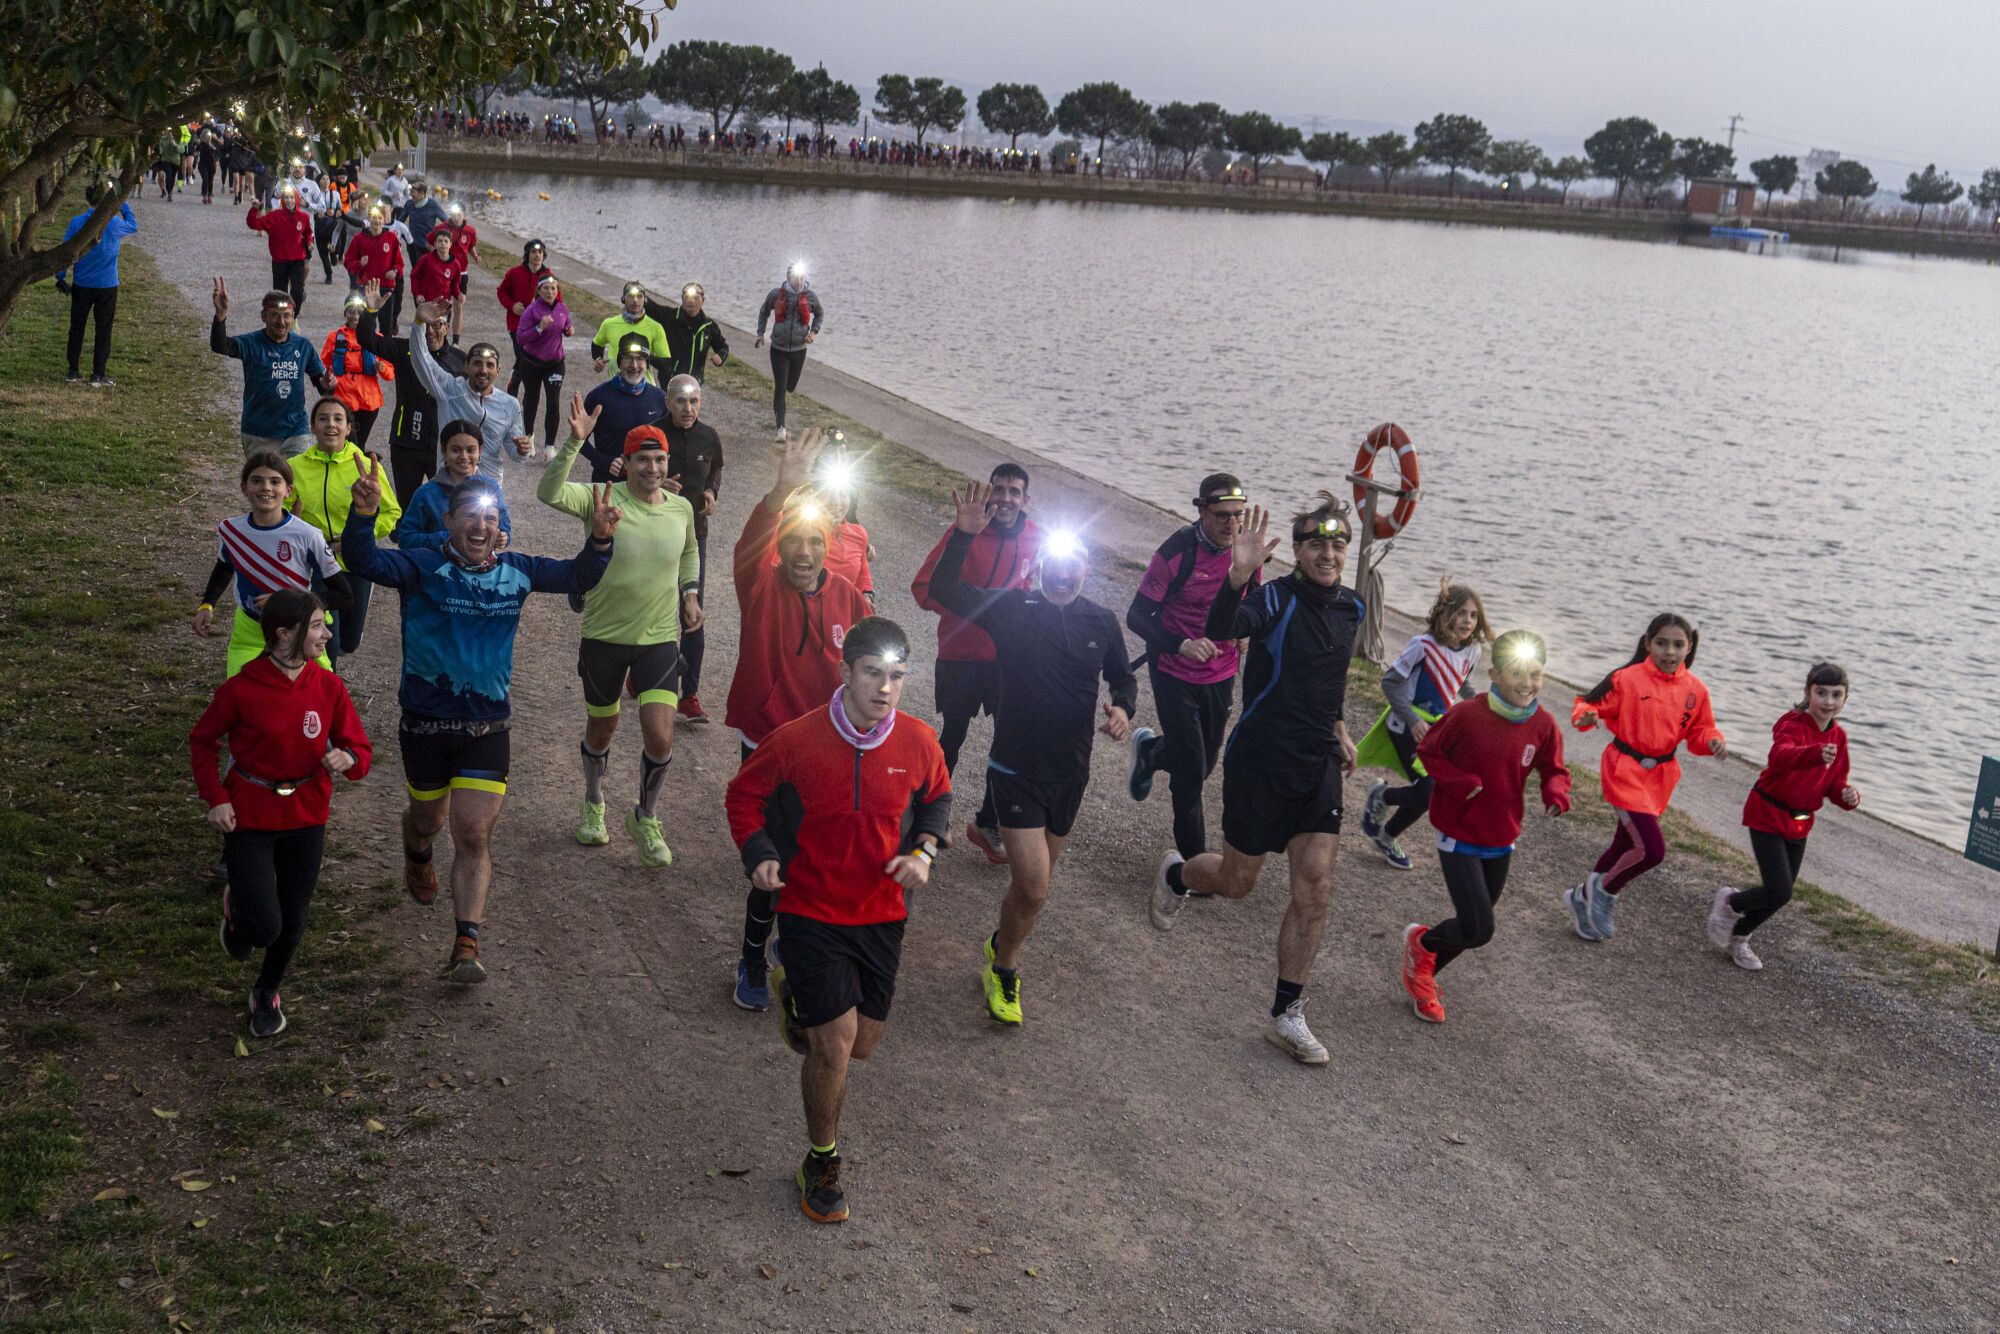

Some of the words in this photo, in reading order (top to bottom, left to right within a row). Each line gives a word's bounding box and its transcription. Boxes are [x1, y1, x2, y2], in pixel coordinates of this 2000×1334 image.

[272, 361, 298, 371] CURSA
[411, 411, 423, 441] JCB
[446, 598, 474, 606] CENTRE
[440, 605, 458, 613] SANT
